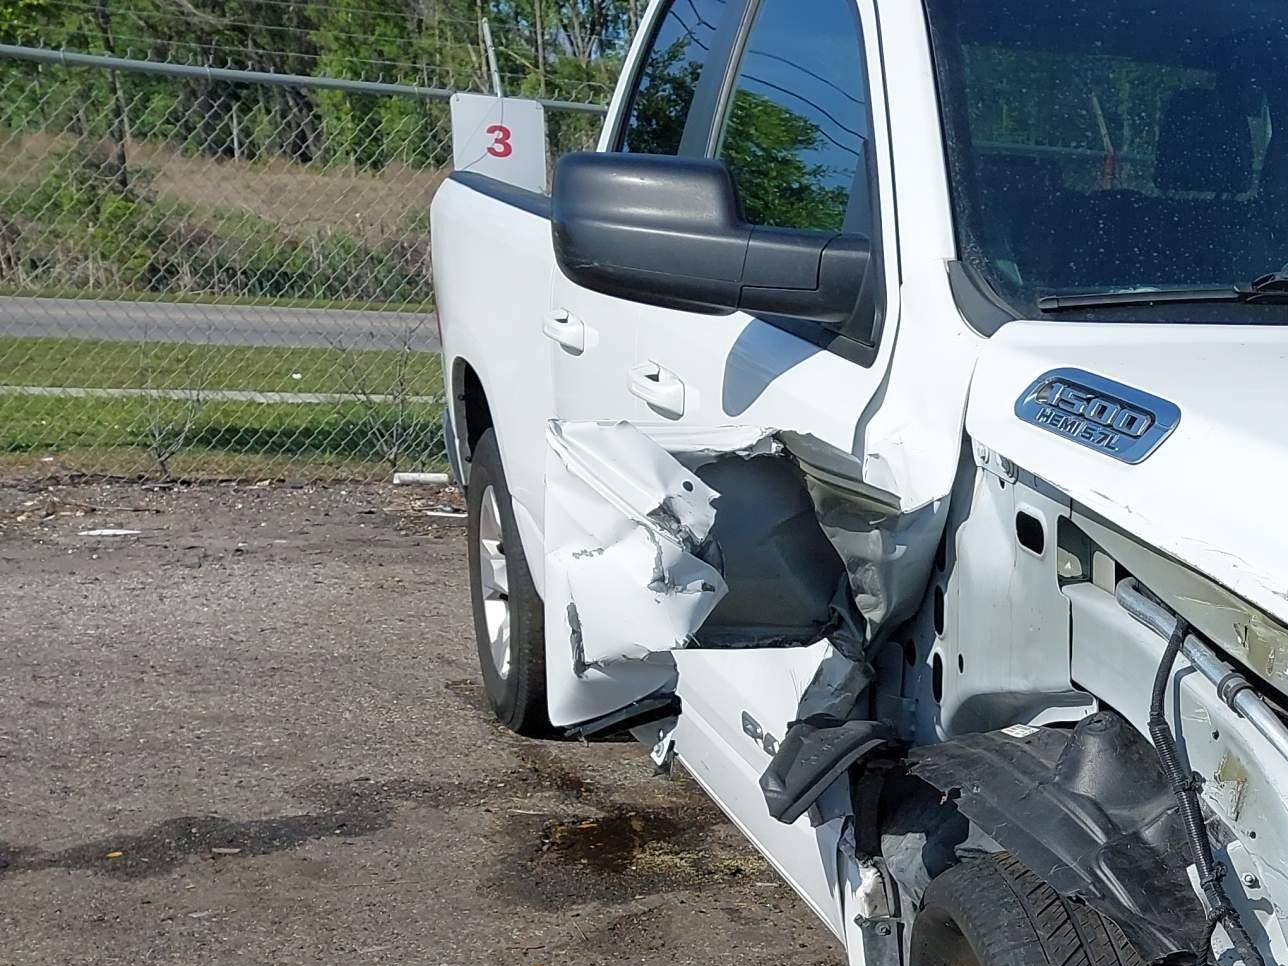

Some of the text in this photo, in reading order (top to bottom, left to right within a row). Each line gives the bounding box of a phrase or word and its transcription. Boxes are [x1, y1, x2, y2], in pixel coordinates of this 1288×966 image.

[486, 124, 513, 158] 3
[1035, 407, 1120, 451] HEMI 5.7L
[1048, 382, 1152, 438] 1500
